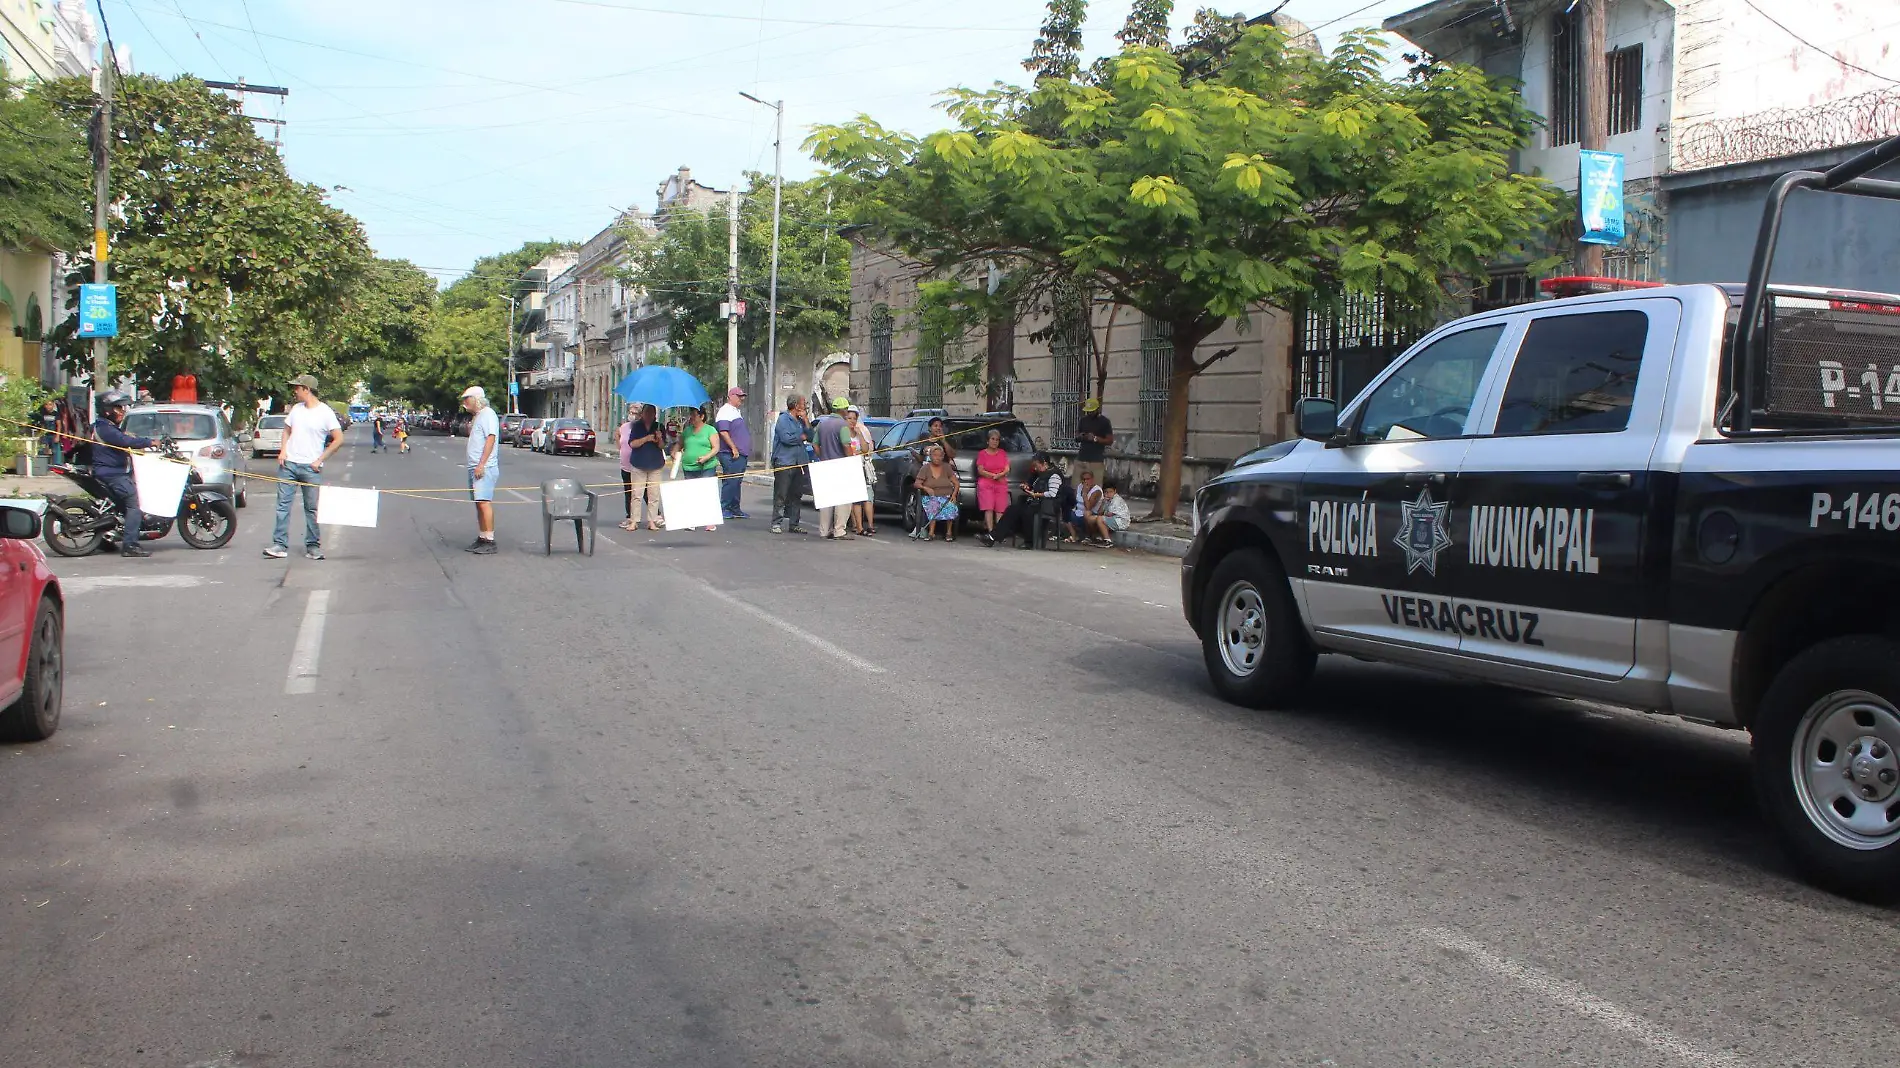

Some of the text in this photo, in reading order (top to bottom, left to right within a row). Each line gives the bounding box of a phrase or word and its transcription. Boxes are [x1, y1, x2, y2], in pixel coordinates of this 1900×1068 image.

[1308, 490, 1599, 574] POLICÍA MUNICIPAL
[1810, 492, 1900, 531] P-146
[1307, 564, 1349, 577] RAM
[1381, 594, 1544, 646] VERACRUZ
